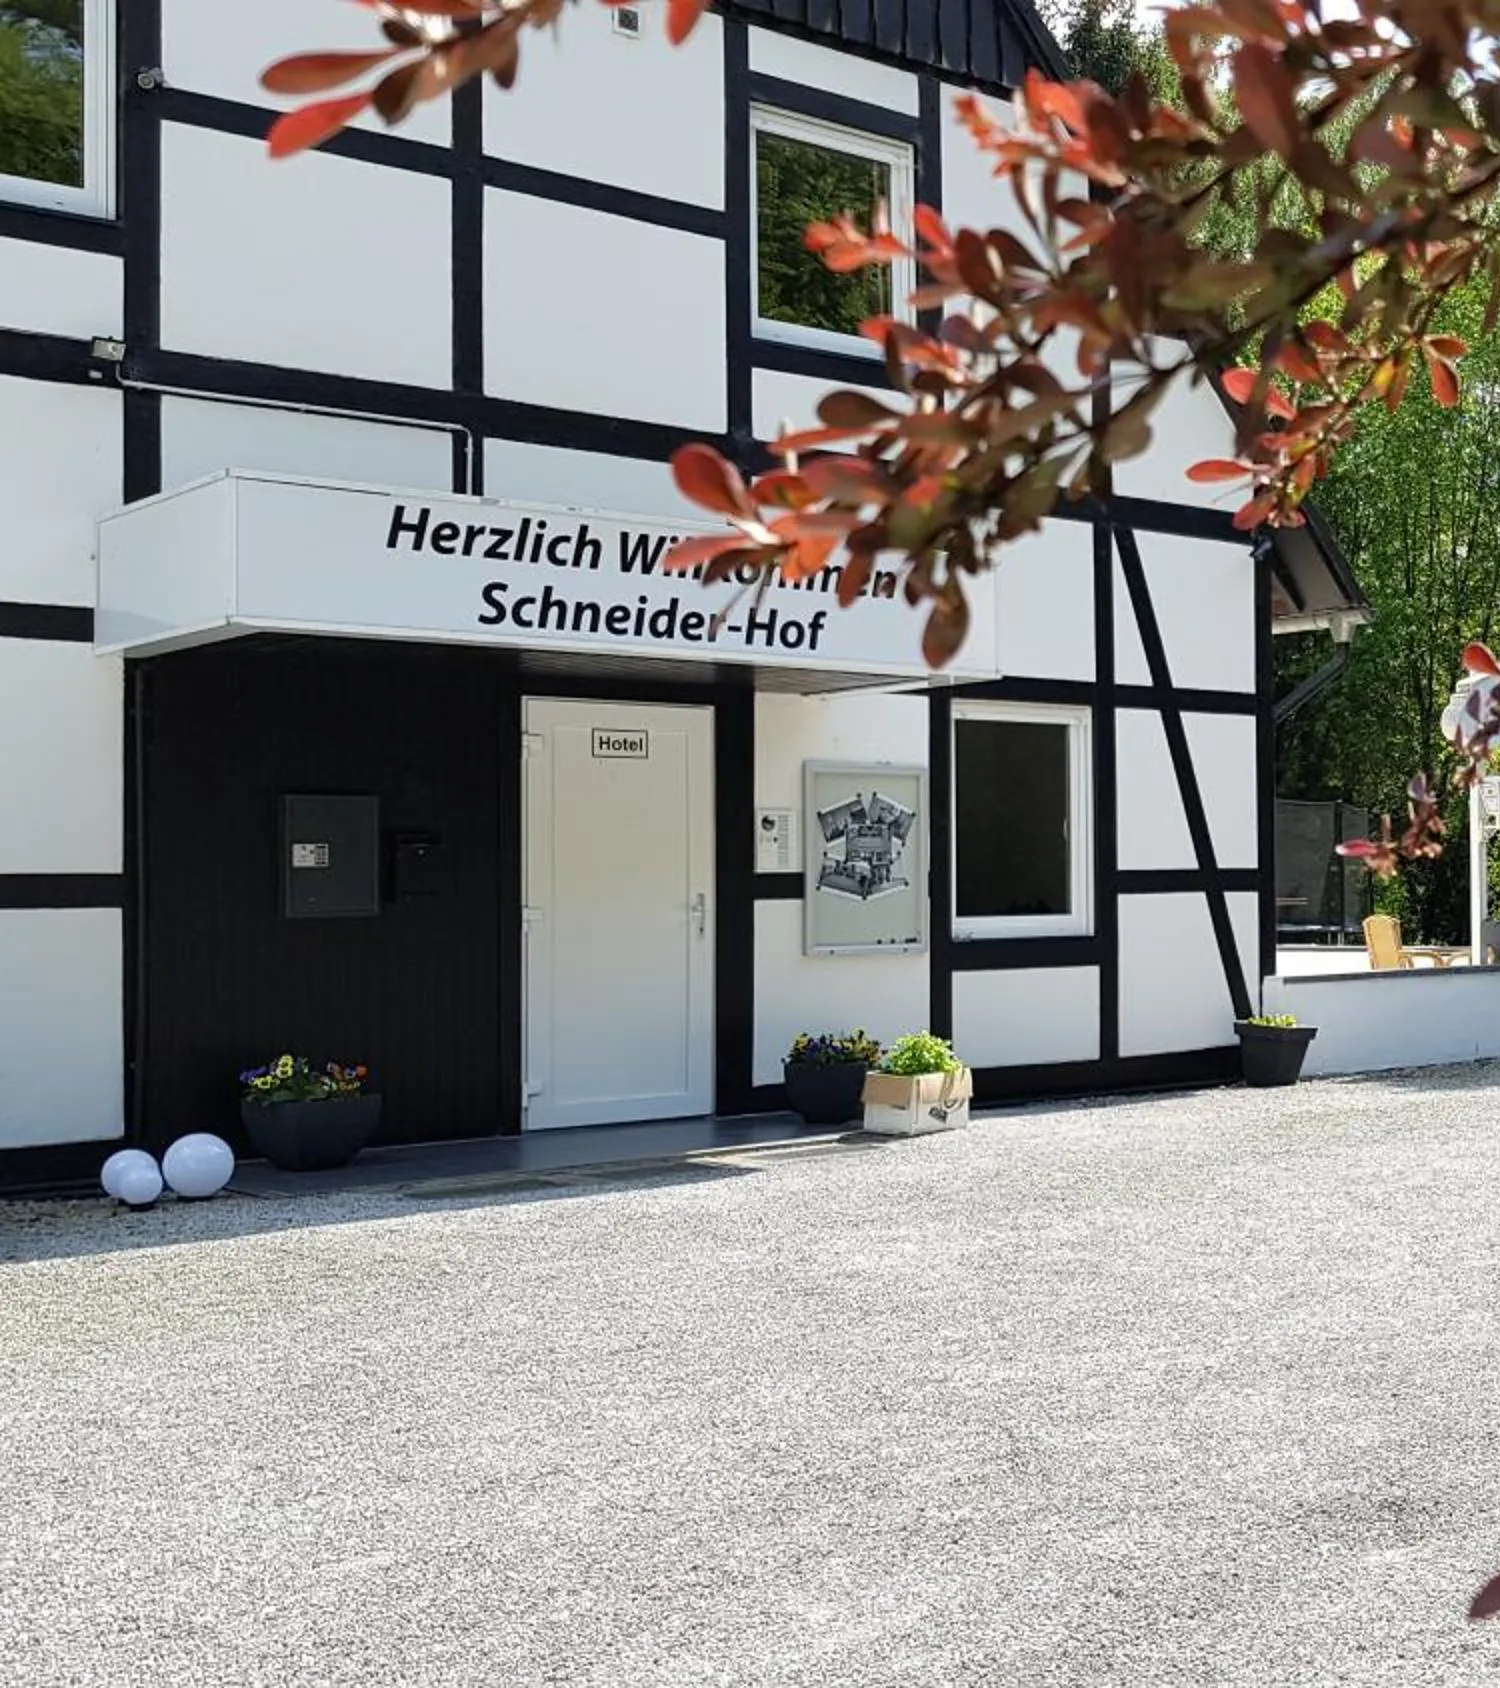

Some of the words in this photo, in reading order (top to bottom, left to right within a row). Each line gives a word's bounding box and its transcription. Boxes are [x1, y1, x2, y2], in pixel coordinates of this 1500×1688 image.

[386, 504, 603, 570] Herzlich
[618, 530, 897, 599] Wiomn
[477, 581, 828, 650] Schneider-Hof
[599, 735, 643, 752] Hotel
